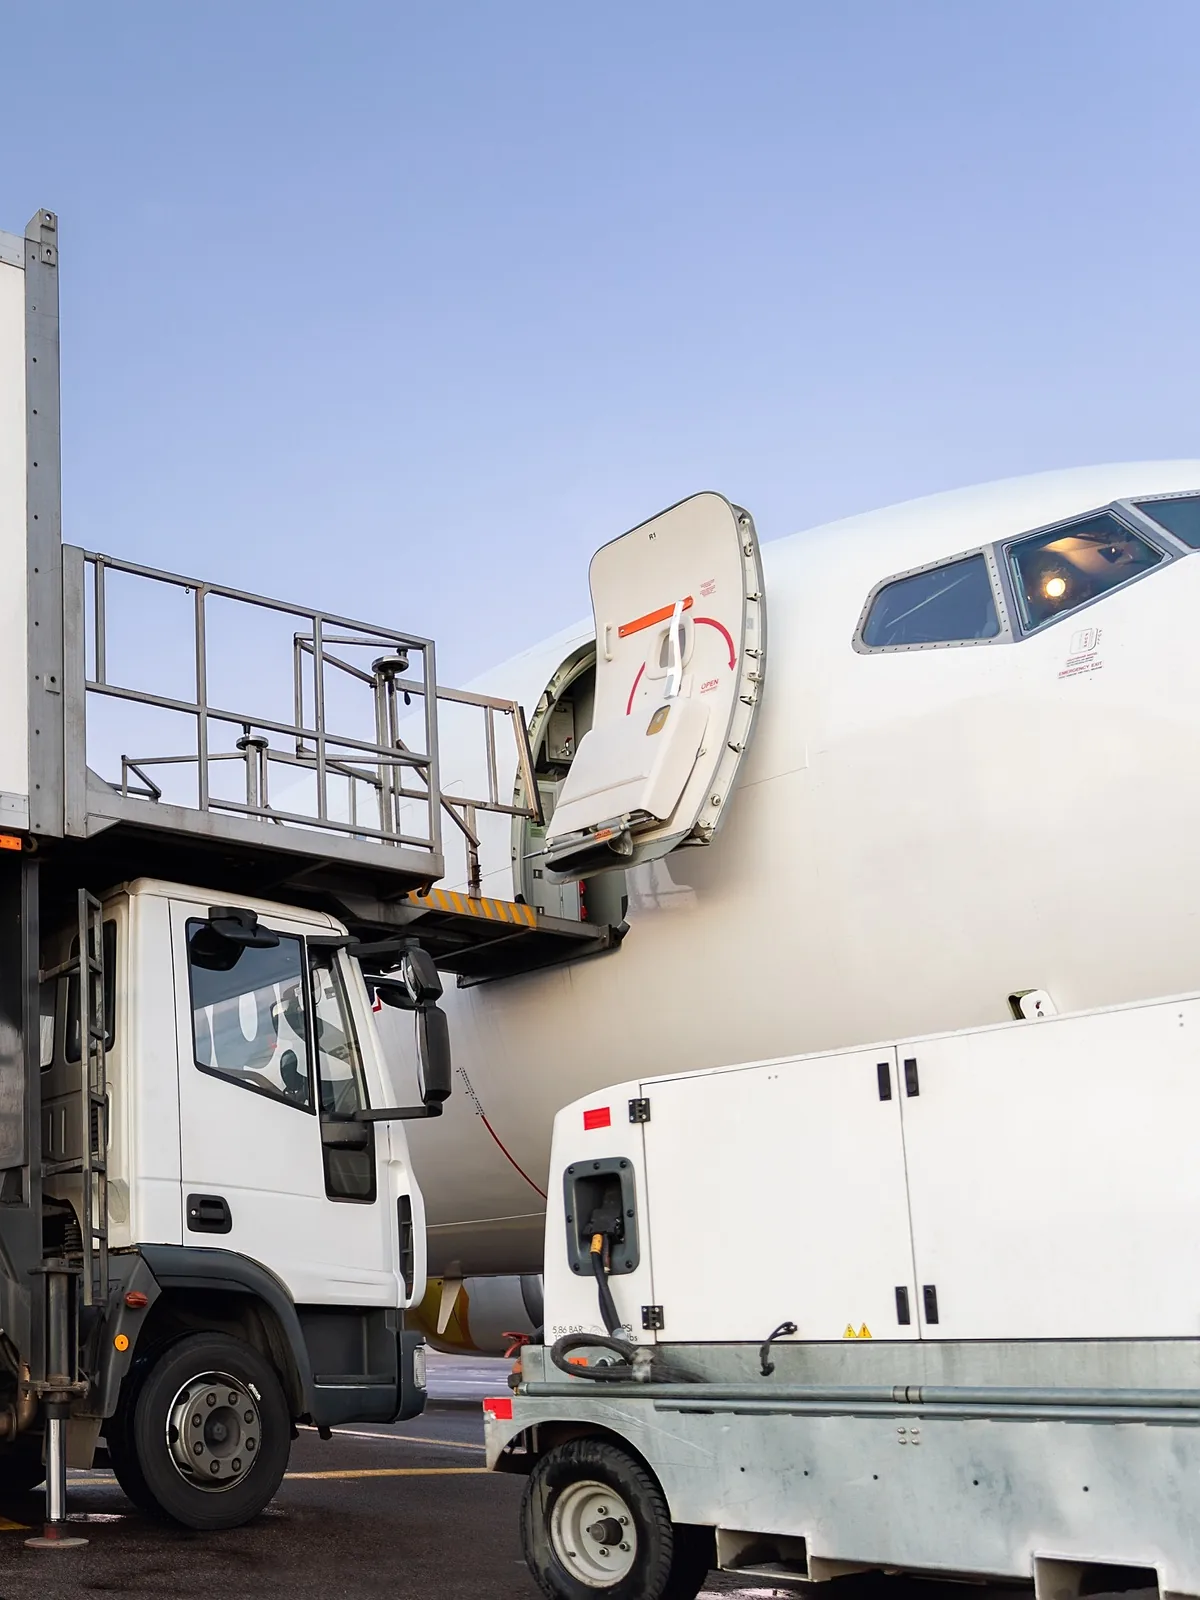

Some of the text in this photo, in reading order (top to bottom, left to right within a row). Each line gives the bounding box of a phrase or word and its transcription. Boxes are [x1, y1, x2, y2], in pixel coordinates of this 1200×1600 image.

[648, 532, 657, 540] R1
[1058, 665, 1090, 676] EMERGENCY
[700, 679, 719, 690] OPEN
[569, 1325, 583, 1334] BAR
